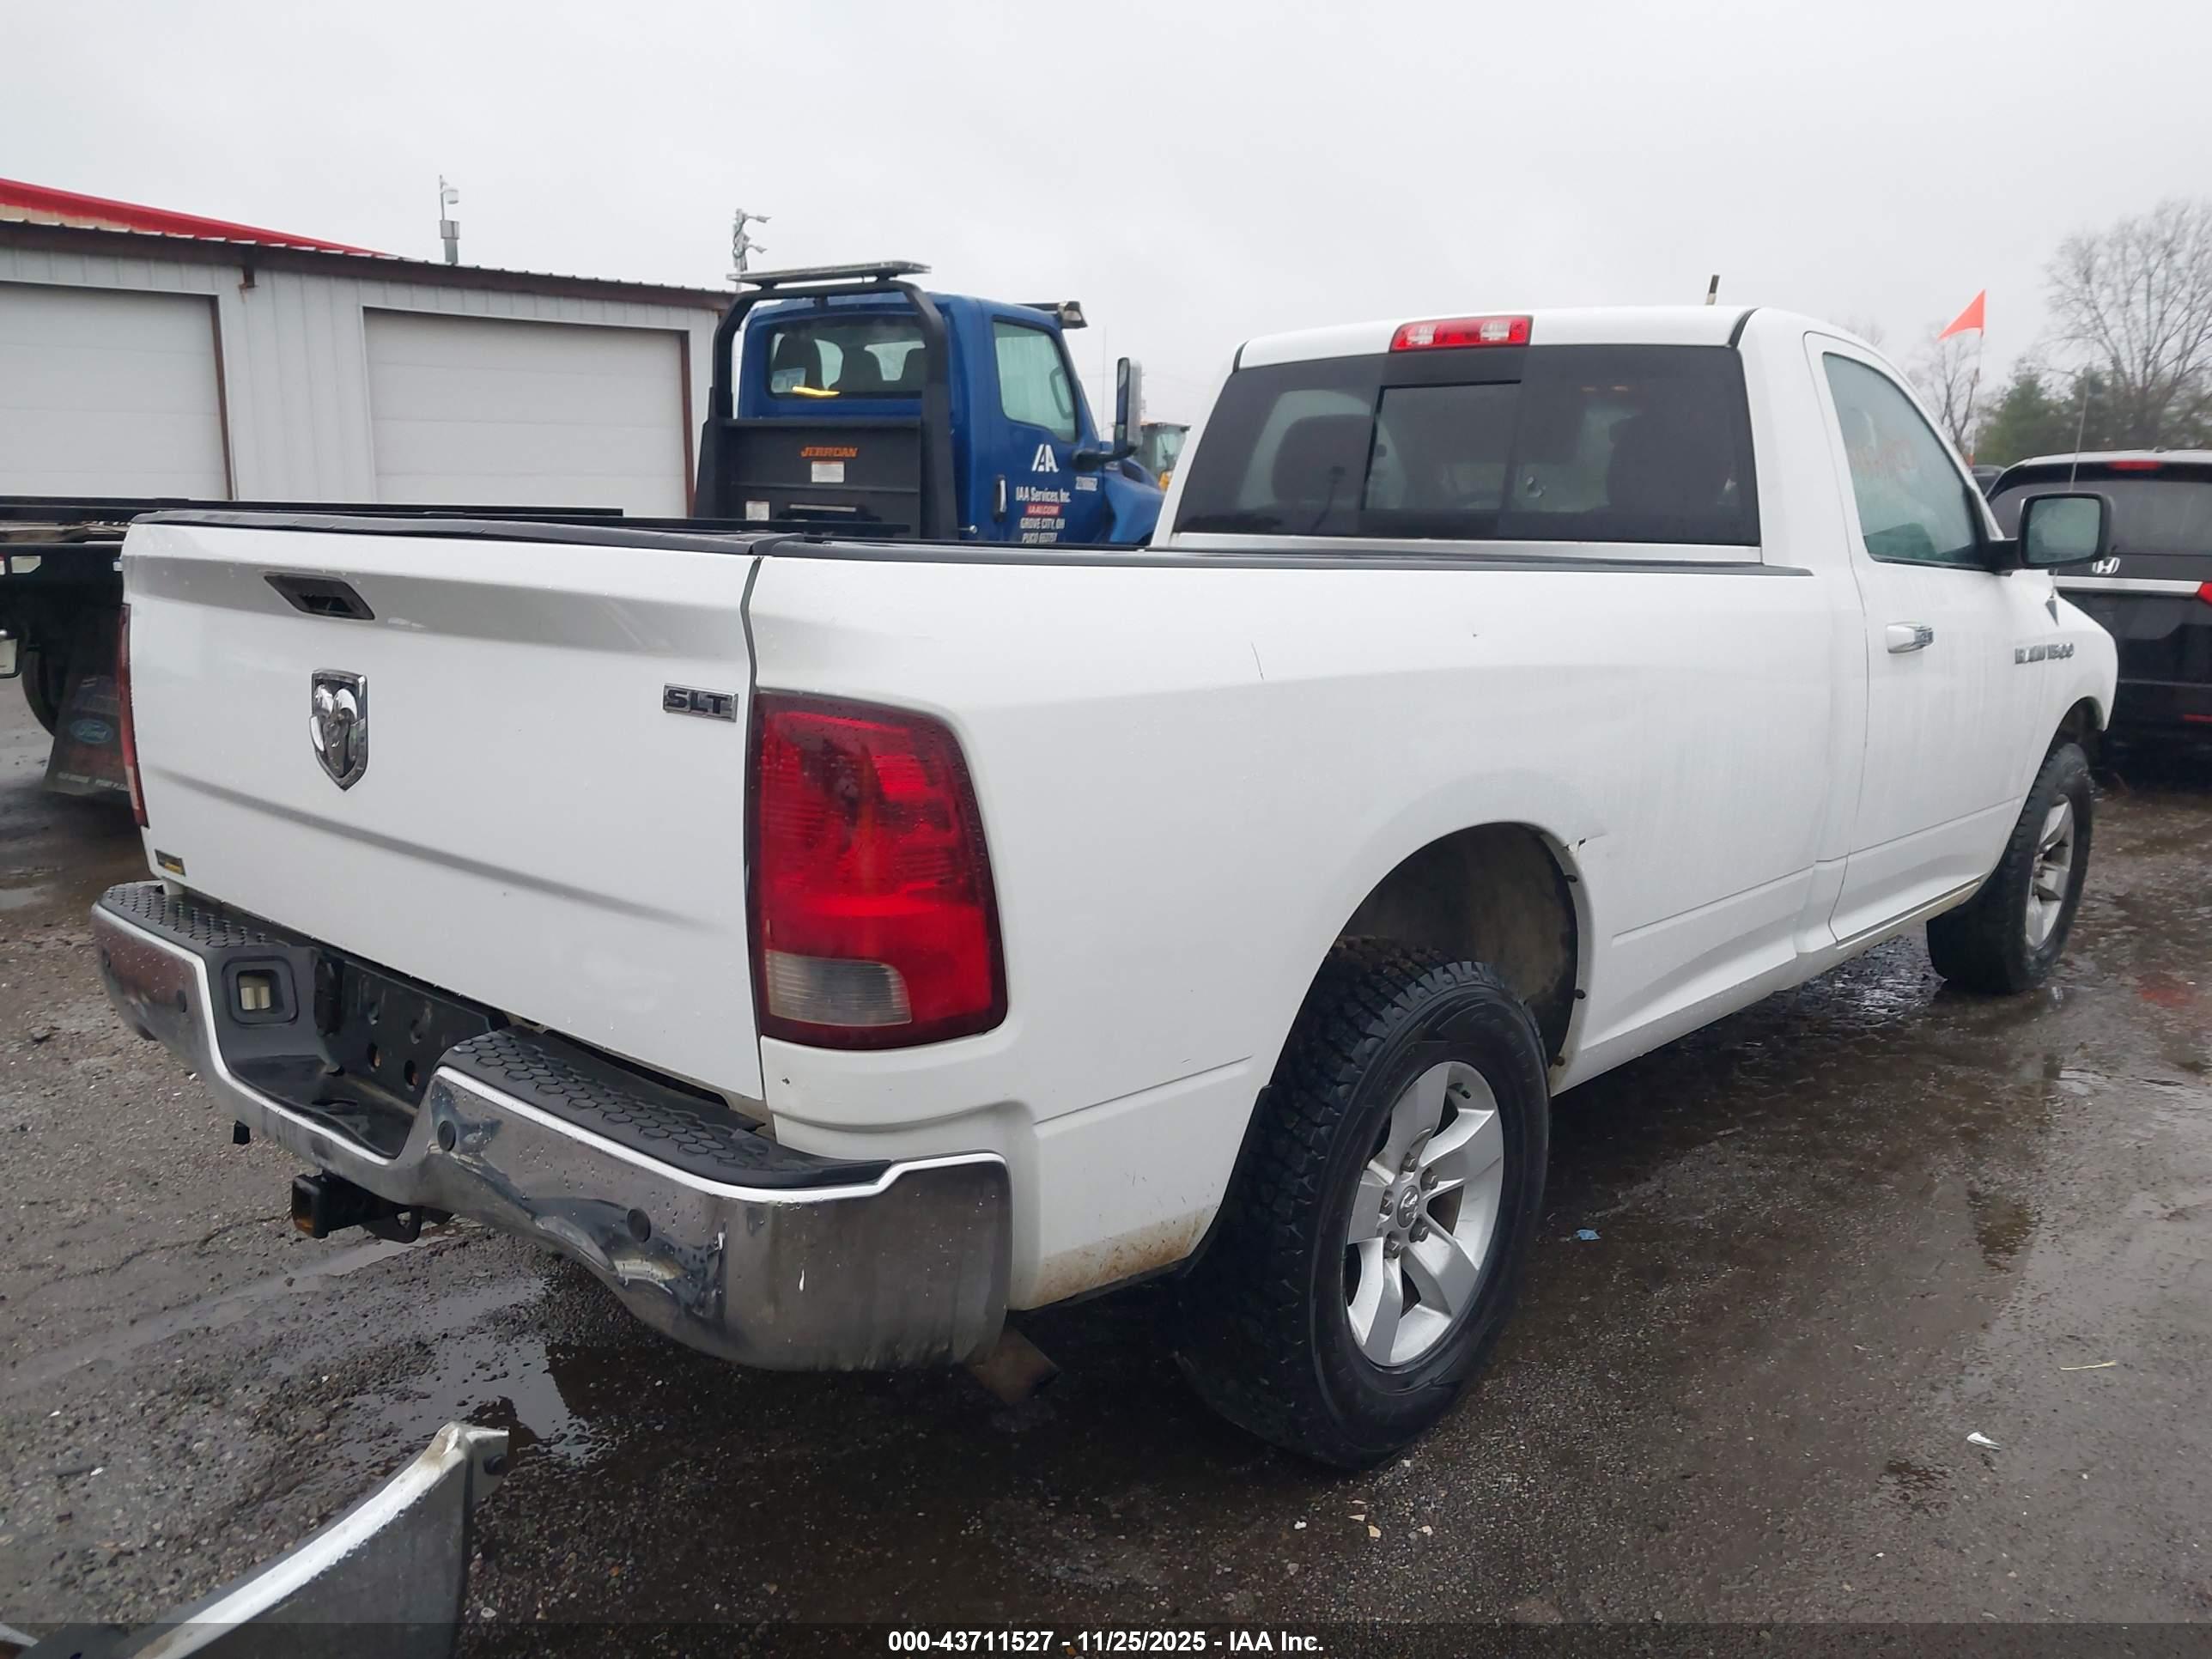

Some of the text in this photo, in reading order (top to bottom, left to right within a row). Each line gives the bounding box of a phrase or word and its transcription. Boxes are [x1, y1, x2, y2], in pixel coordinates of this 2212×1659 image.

[1016, 486, 1072, 503] IAA Services, Inc.
[1019, 517, 1041, 529] GROVE
[665, 688, 731, 715] SLT
